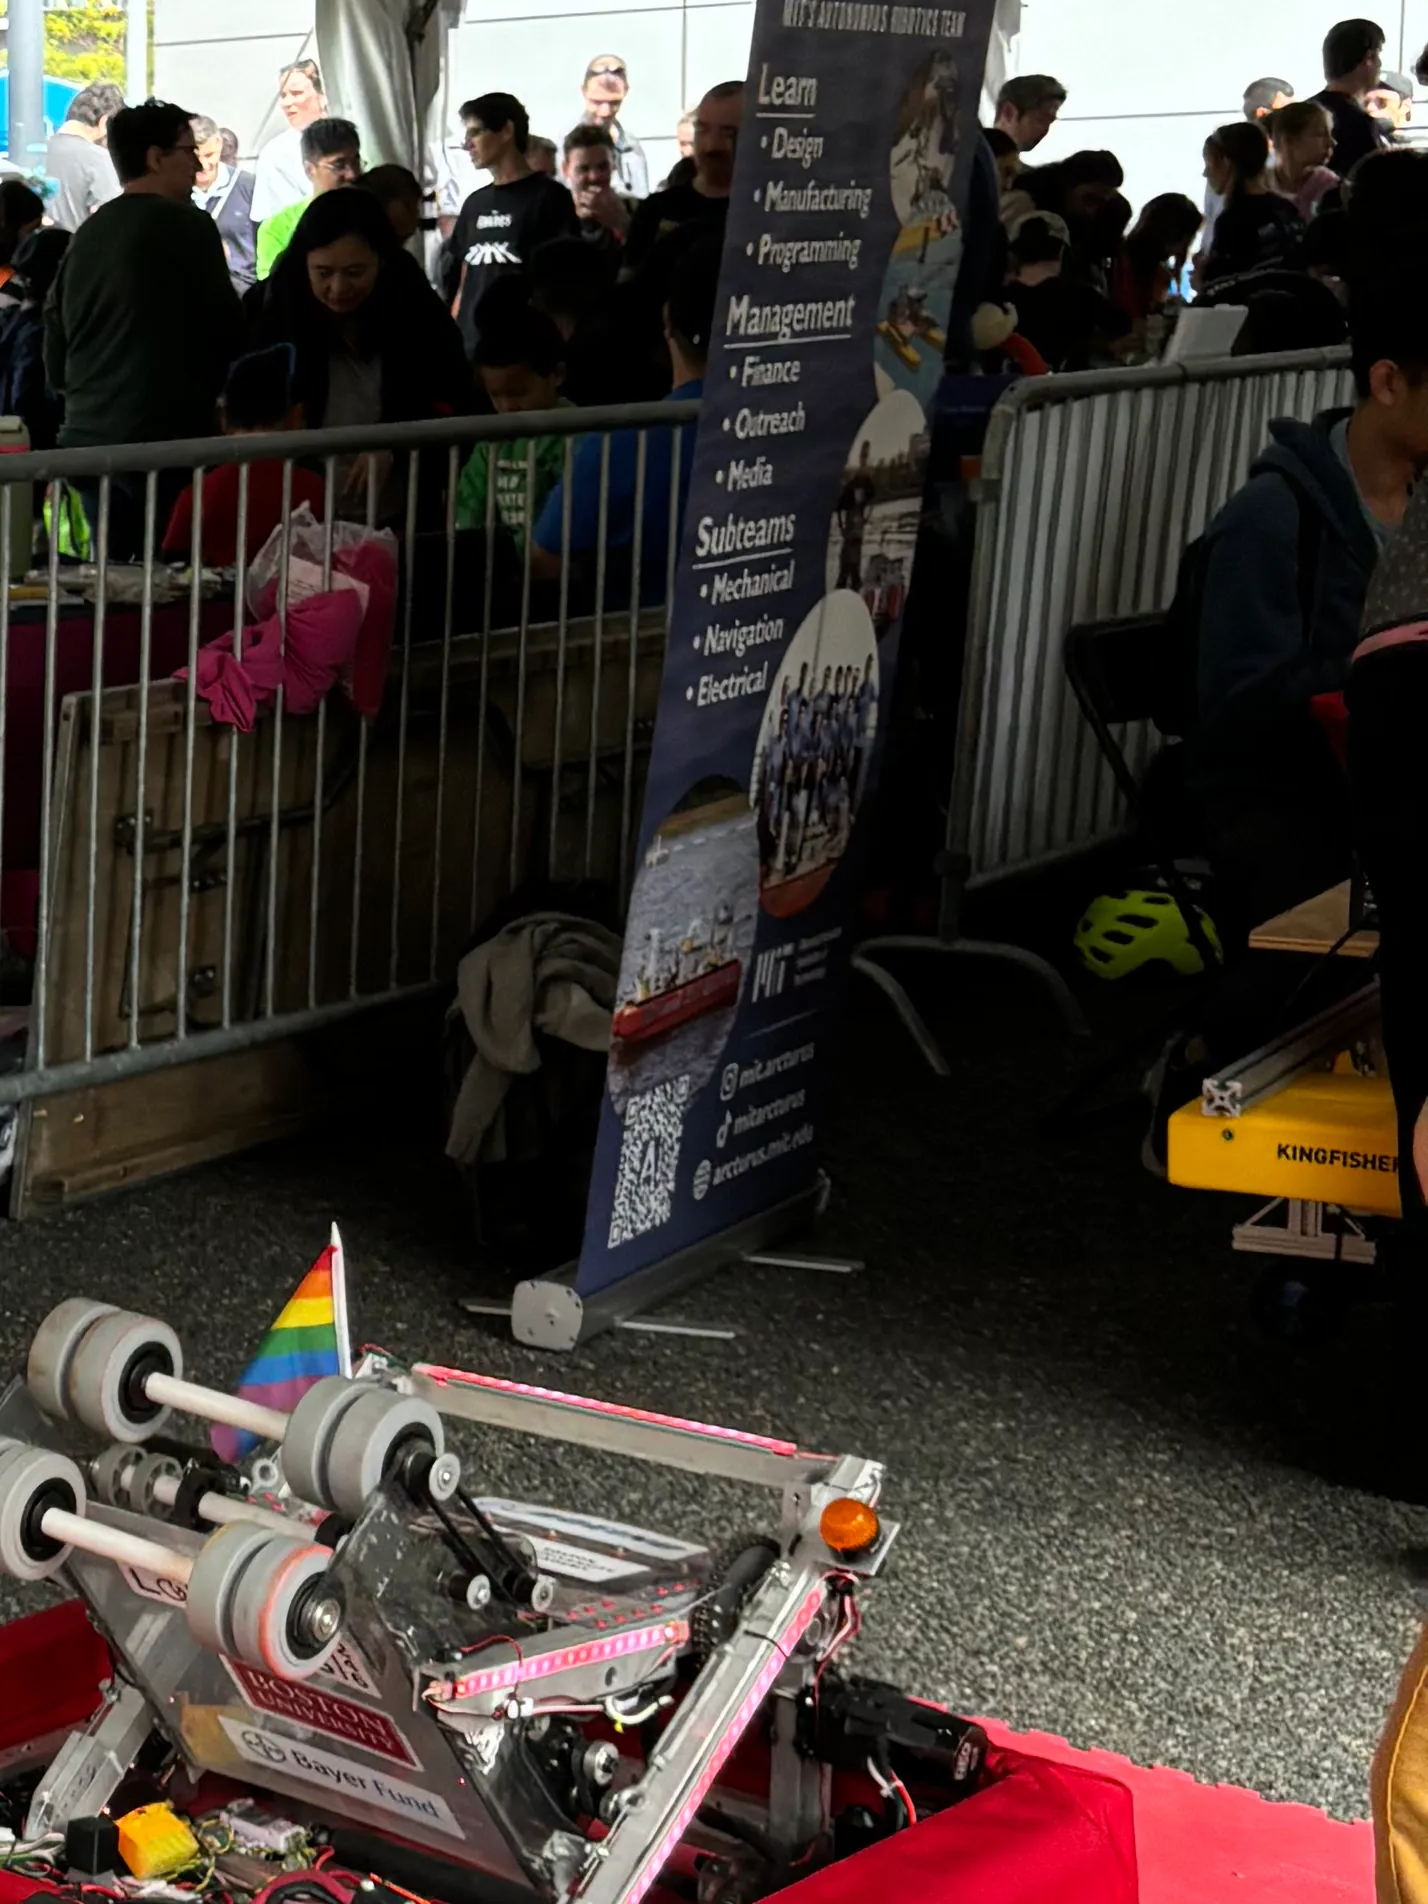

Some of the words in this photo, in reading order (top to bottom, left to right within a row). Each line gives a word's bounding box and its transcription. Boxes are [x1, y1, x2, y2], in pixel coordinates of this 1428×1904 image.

[757, 62, 817, 106] Learn
[771, 126, 824, 169] Design
[764, 179, 873, 219] Manufacturing
[757, 232, 862, 273] Programming
[726, 293, 856, 342] Management
[741, 355, 801, 388] Finance
[735, 401, 806, 439] Outreach
[727, 456, 773, 491] Media
[695, 512, 796, 558] Subteams
[711, 559, 795, 605] Mechanical
[703, 613, 784, 658] Navigation
[696, 661, 768, 707] Electrical
[249, 1671, 386, 1736] BOSTON
[257, 1690, 393, 1750] UNIVERSITY
[291, 1750, 367, 1790] Bayer
[374, 1782, 441, 1818] Fund
